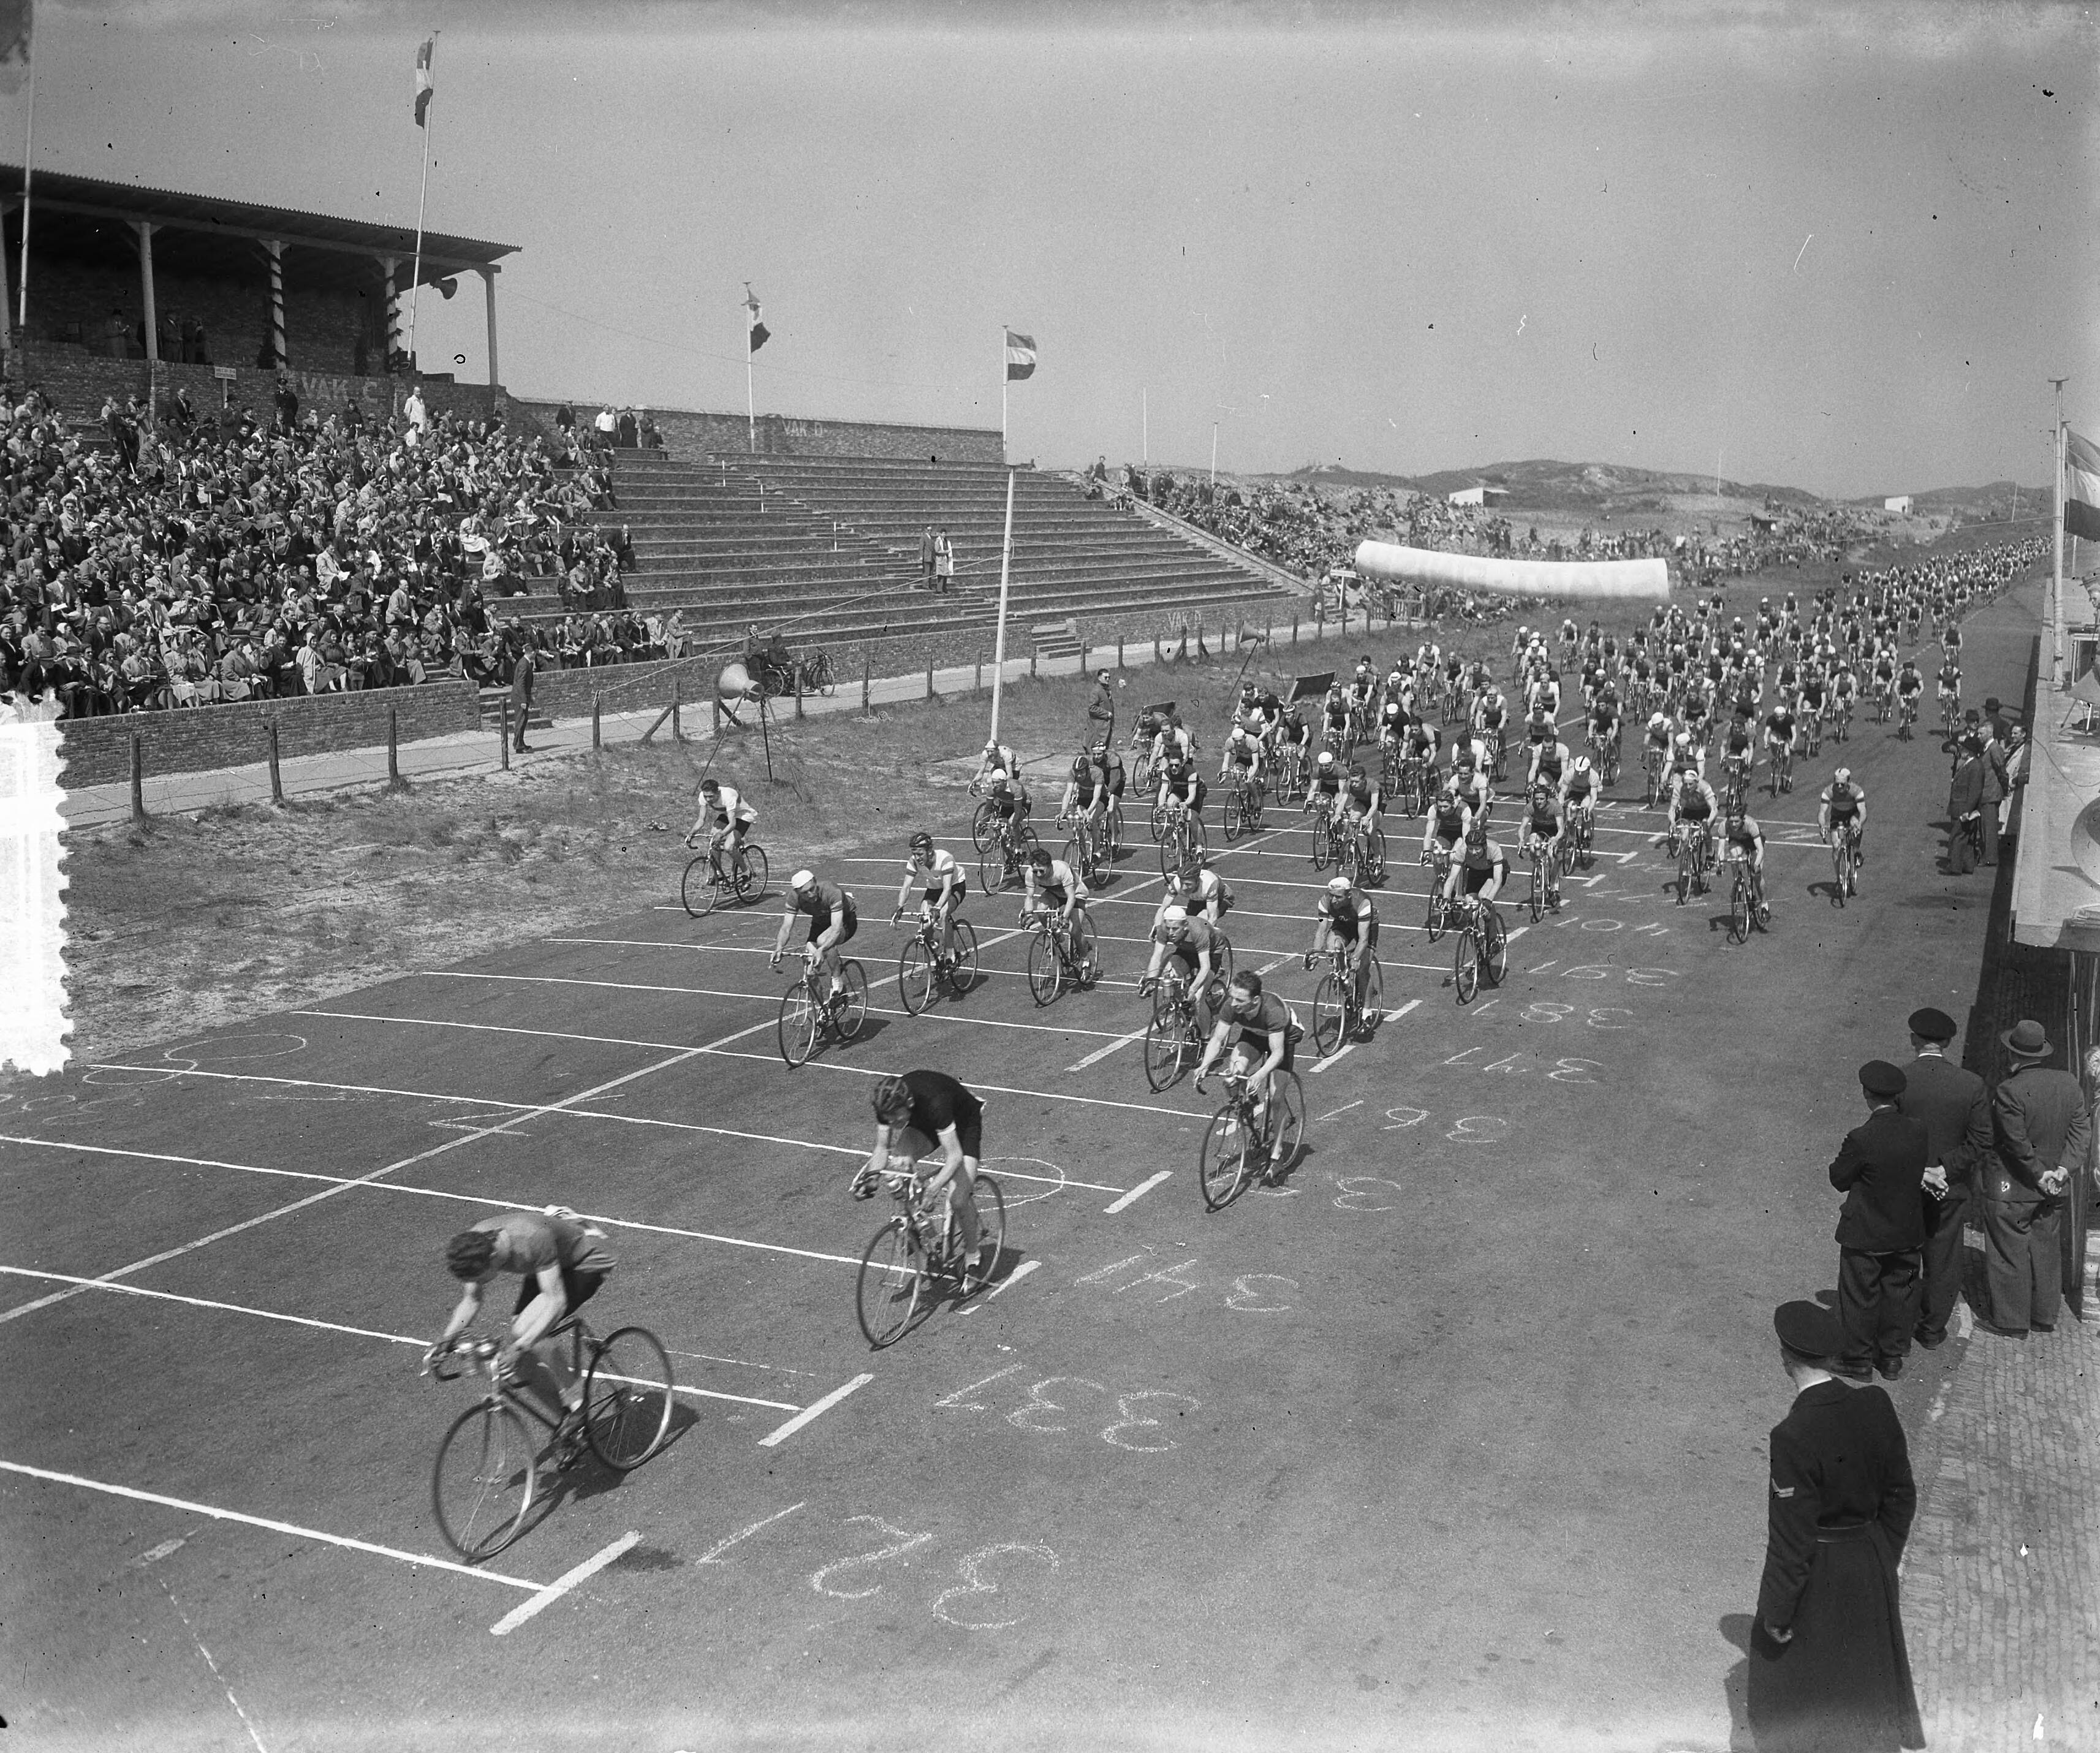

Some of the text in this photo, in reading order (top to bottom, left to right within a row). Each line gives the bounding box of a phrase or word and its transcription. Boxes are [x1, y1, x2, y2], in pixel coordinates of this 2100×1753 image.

[301, 376, 349, 401] VAK
[783, 420, 807, 437] VAK
[1168, 611, 1190, 632] VAK
